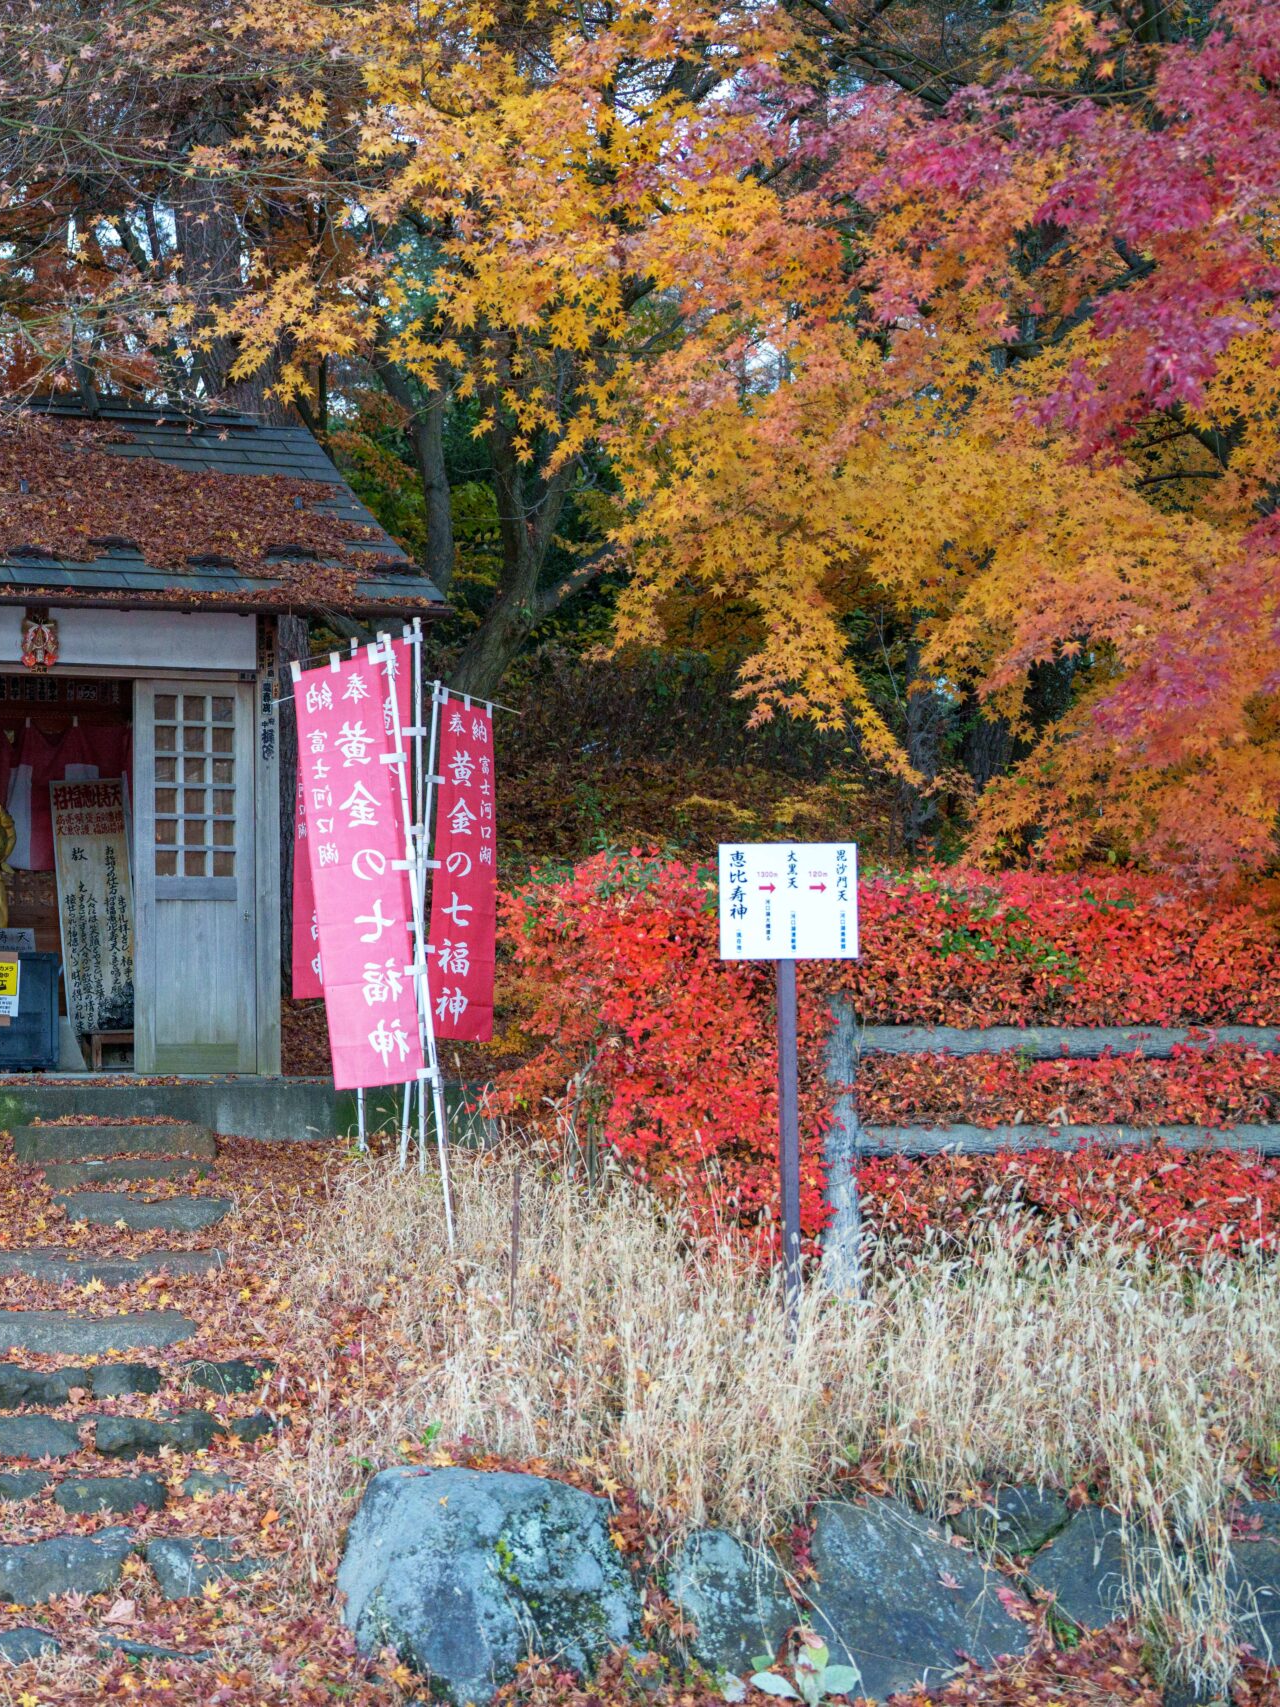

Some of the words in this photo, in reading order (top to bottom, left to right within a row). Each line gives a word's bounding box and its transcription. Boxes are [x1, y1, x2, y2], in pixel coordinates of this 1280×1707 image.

[448, 712, 488, 743] 奉納
[479, 756, 492, 866] 富士河口湖
[435, 750, 477, 1026] 黄金の七福神
[730, 851, 748, 920] 恵比寿神
[787, 850, 798, 889] 大黒天
[836, 849, 848, 902] 毘沙門天
